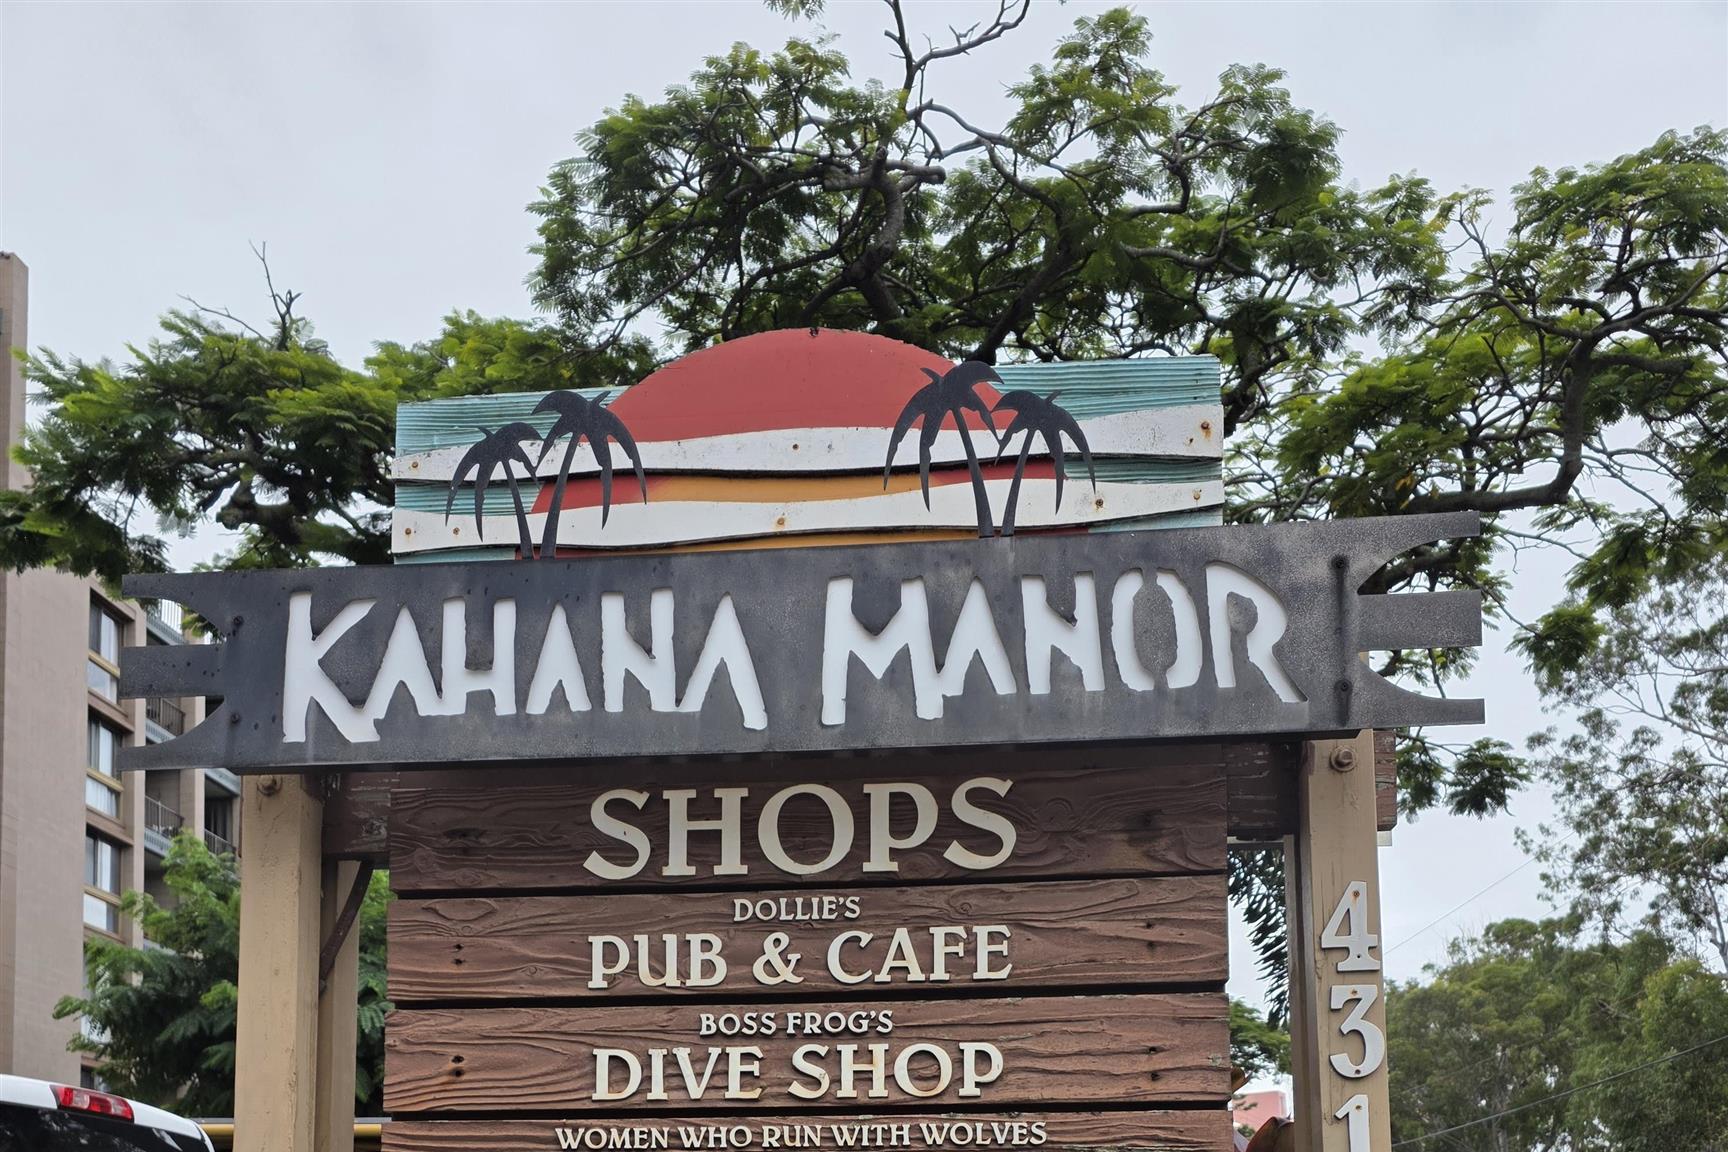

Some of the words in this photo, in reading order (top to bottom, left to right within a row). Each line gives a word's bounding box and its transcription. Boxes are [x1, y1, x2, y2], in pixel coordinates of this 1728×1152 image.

[282, 592, 768, 743] KAHANA
[820, 560, 1307, 727] MANOR
[582, 777, 1017, 880] SHOPS
[733, 896, 861, 922] DOLLIE'S
[588, 933, 727, 988] PUB
[752, 932, 804, 986] &
[827, 925, 1012, 984] CAFE
[699, 1012, 776, 1036] BOSS
[786, 1010, 893, 1035] FROG'S
[591, 1046, 763, 1100] DIVE
[787, 1042, 1003, 1098] SHOP
[555, 1127, 669, 1150] WOMEN
[677, 1126, 752, 1149] WHO
[762, 1125, 822, 1148] RUN
[831, 1123, 911, 1147] WITH
[920, 1121, 1047, 1145] WOLVES
